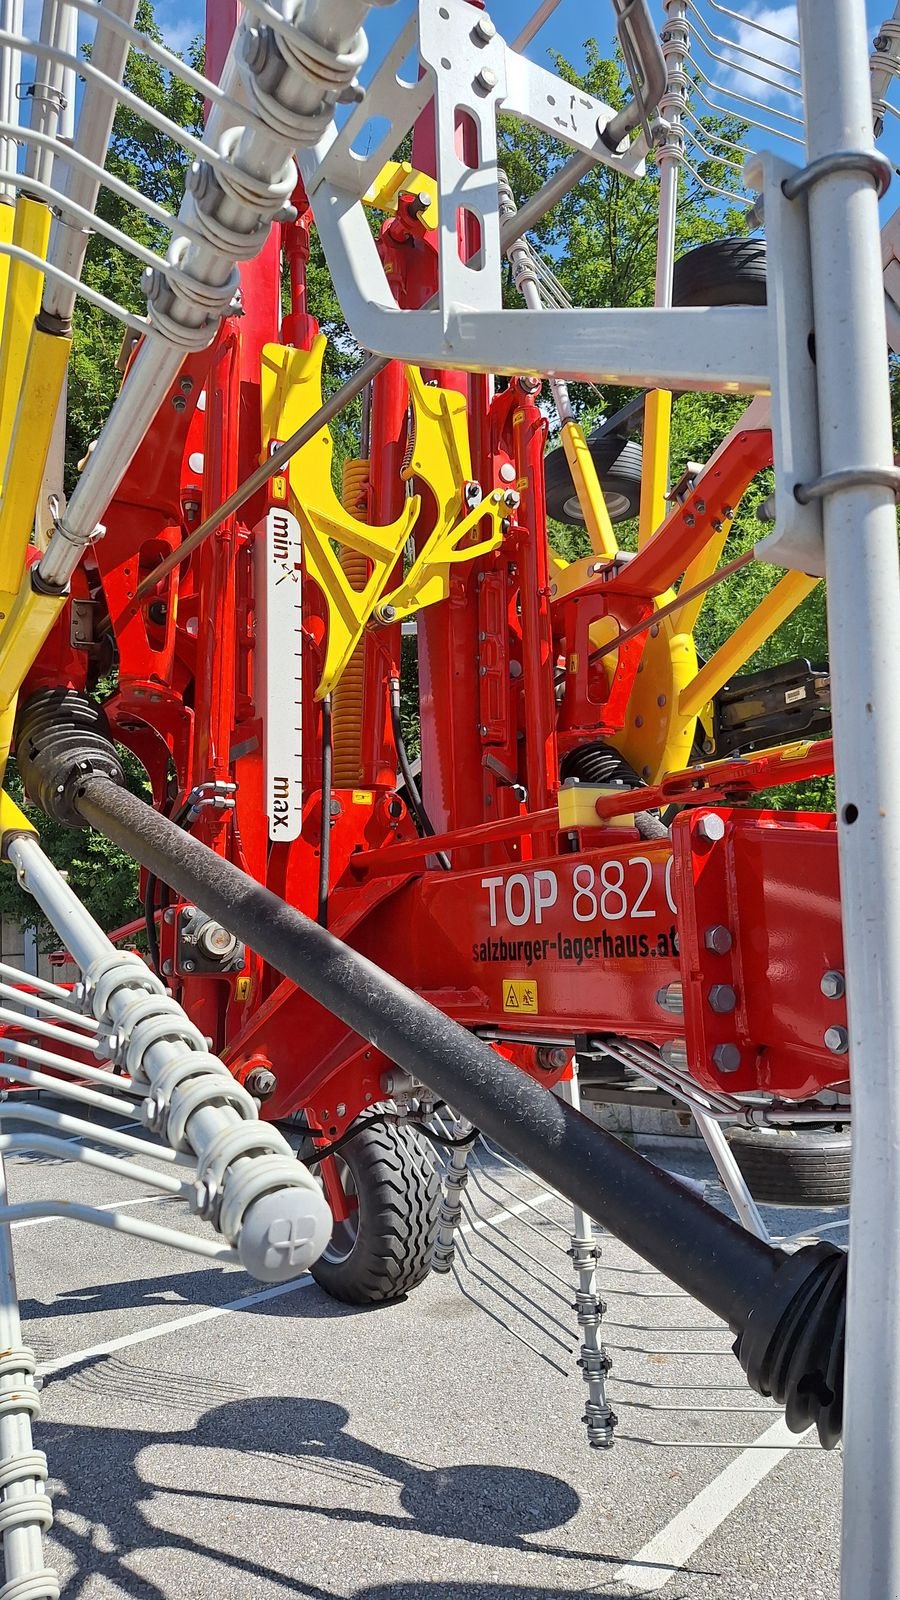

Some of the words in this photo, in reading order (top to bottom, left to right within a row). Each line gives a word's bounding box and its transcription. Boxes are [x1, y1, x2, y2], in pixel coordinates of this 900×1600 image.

[273, 515, 292, 564] min.
[273, 777, 289, 833] max.
[481, 870, 558, 927] TOP
[472, 925, 679, 967] salzburger-lagerhaus.at
